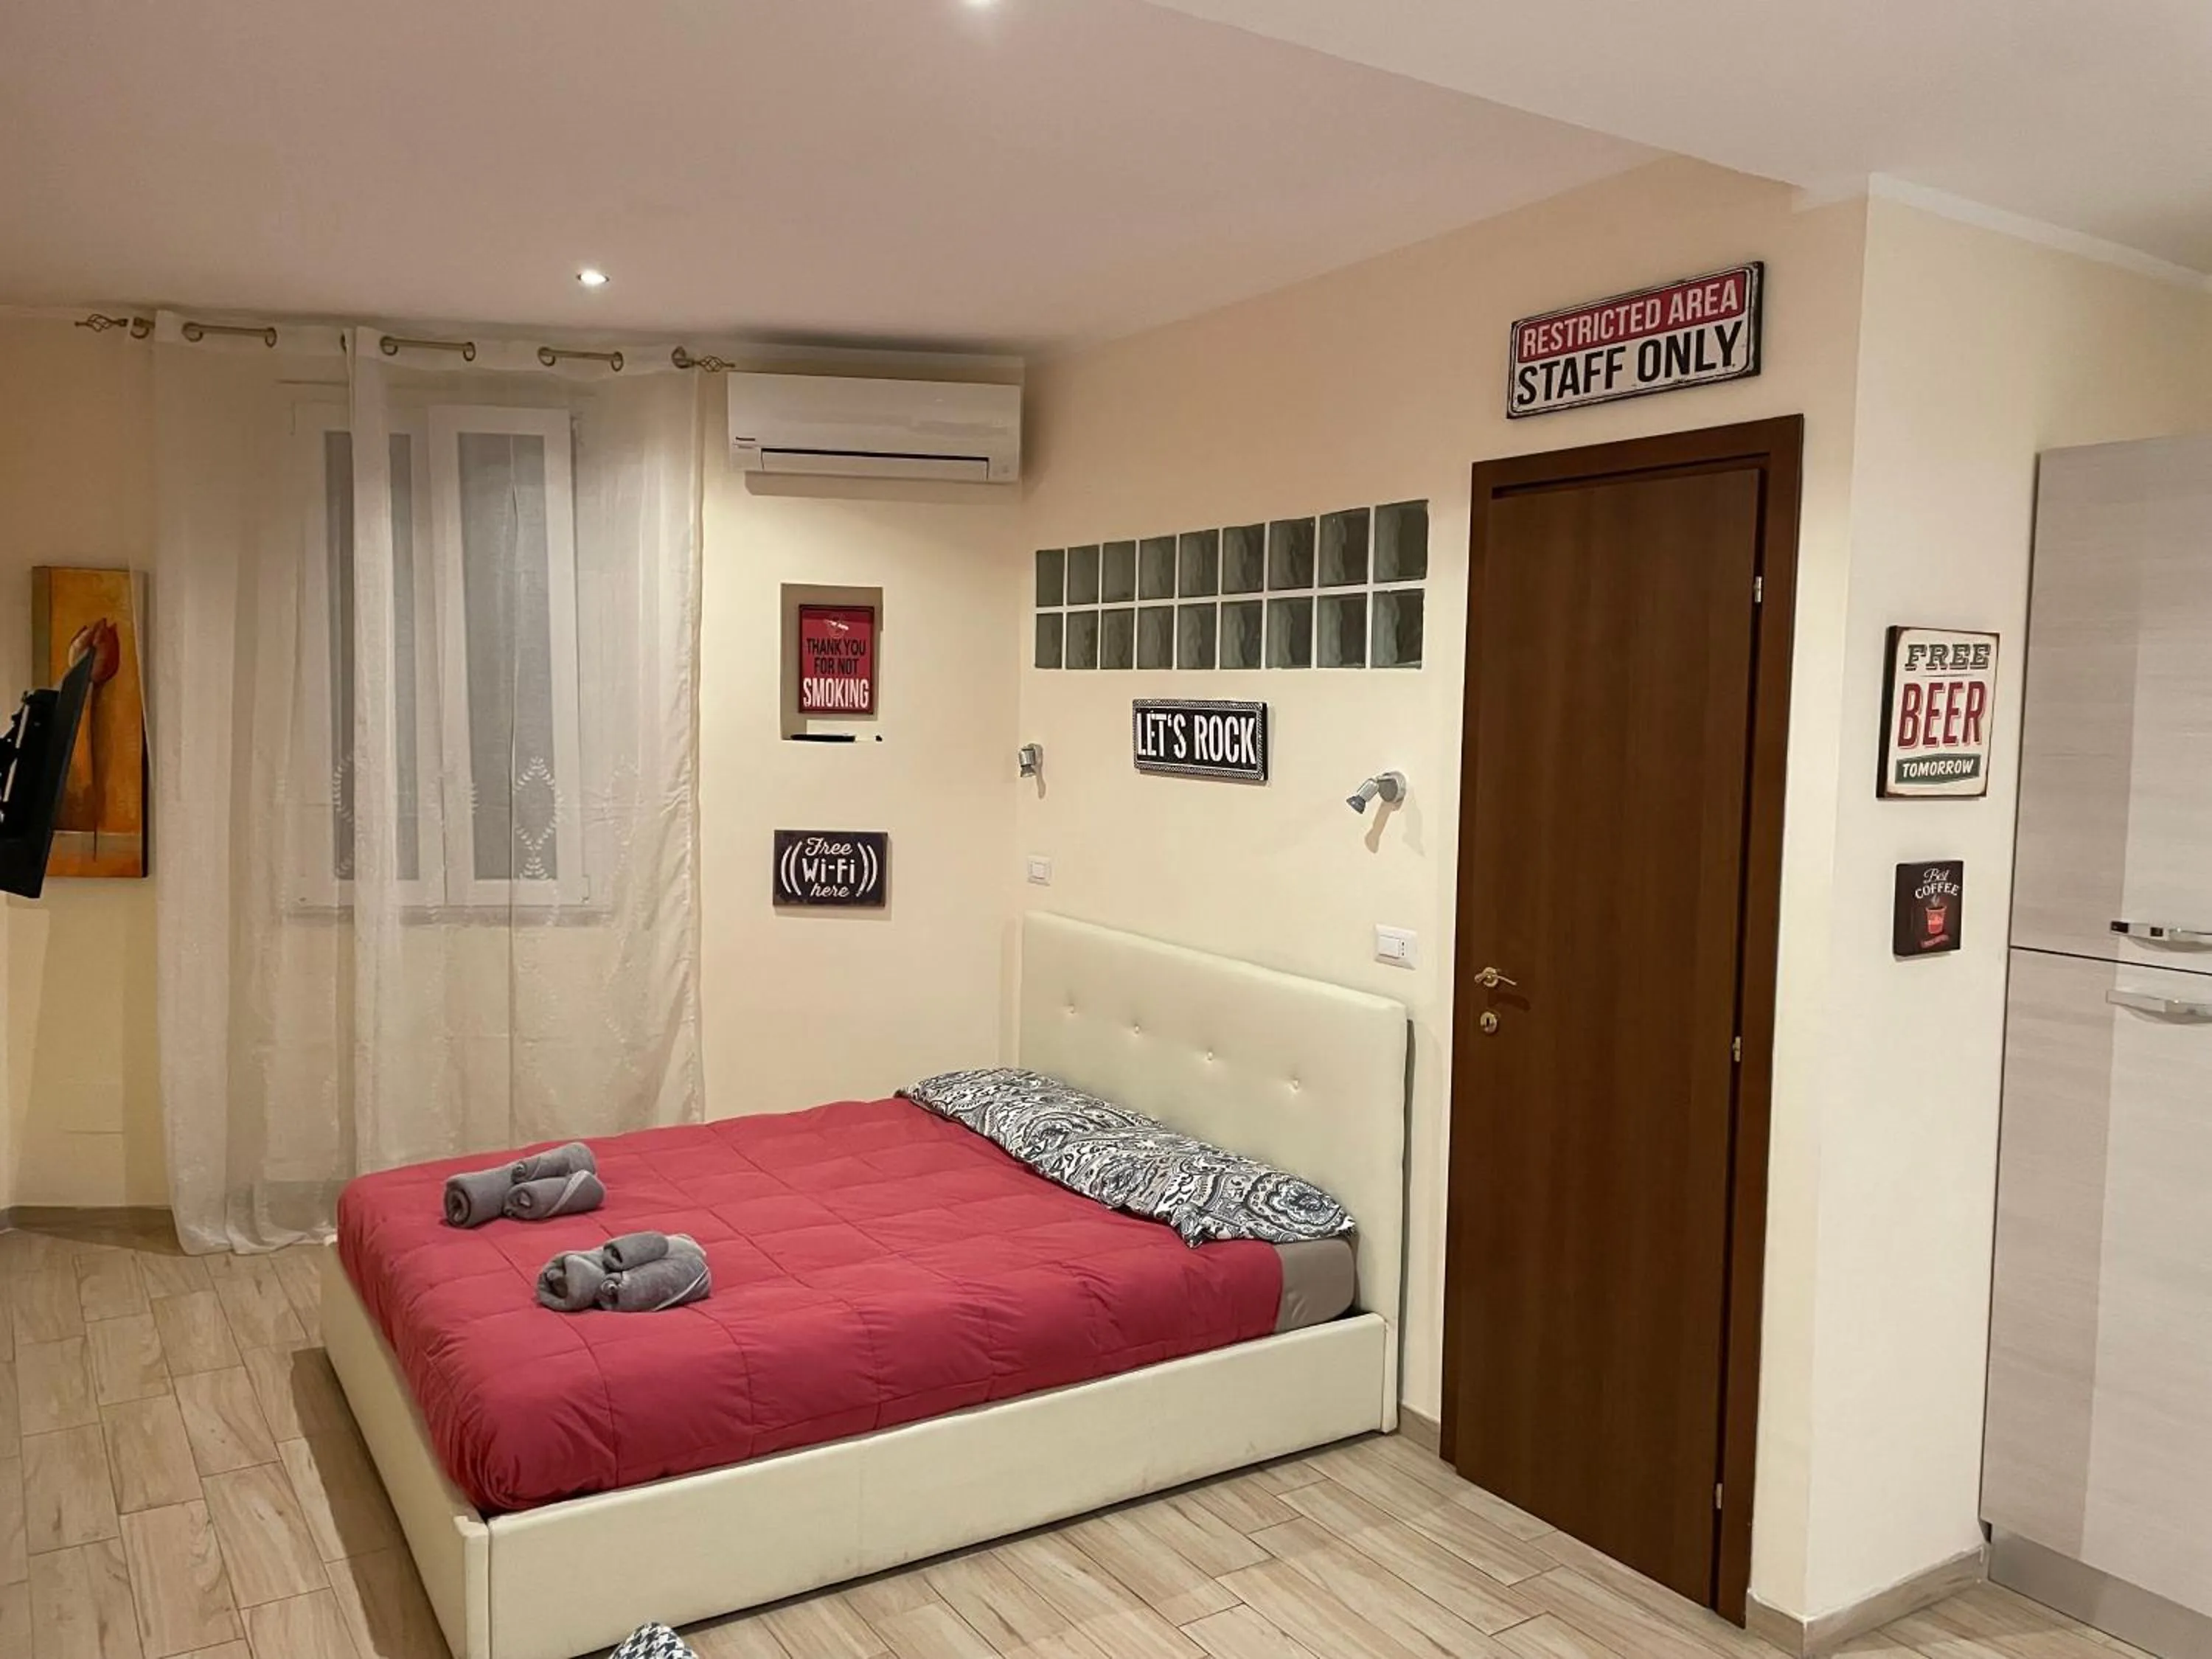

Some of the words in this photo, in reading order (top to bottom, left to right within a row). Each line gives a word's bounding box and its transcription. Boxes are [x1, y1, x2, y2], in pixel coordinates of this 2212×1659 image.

[1523, 298, 1662, 358] RESTRICTED
[1668, 279, 1738, 325] AREA
[1517, 346, 1626, 406] STAFF
[1637, 321, 1742, 383] ONLY
[807, 638, 841, 655] THANK
[845, 639, 866, 656] YOU
[1905, 644, 1991, 671] FREE
[814, 656, 835, 675] FOR
[839, 658, 859, 675] NOT
[803, 678, 869, 708] SMOKING
[1897, 681, 1986, 749] BEER
[1136, 713, 1186, 759] LET'S
[1194, 714, 1256, 764] ROCK
[1902, 758, 1974, 778] TOMORROW
[804, 837, 853, 856] Free
[801, 858, 855, 883] Wi-Fi
[810, 883, 850, 897] here
[1915, 882, 1959, 899] COFFEE
